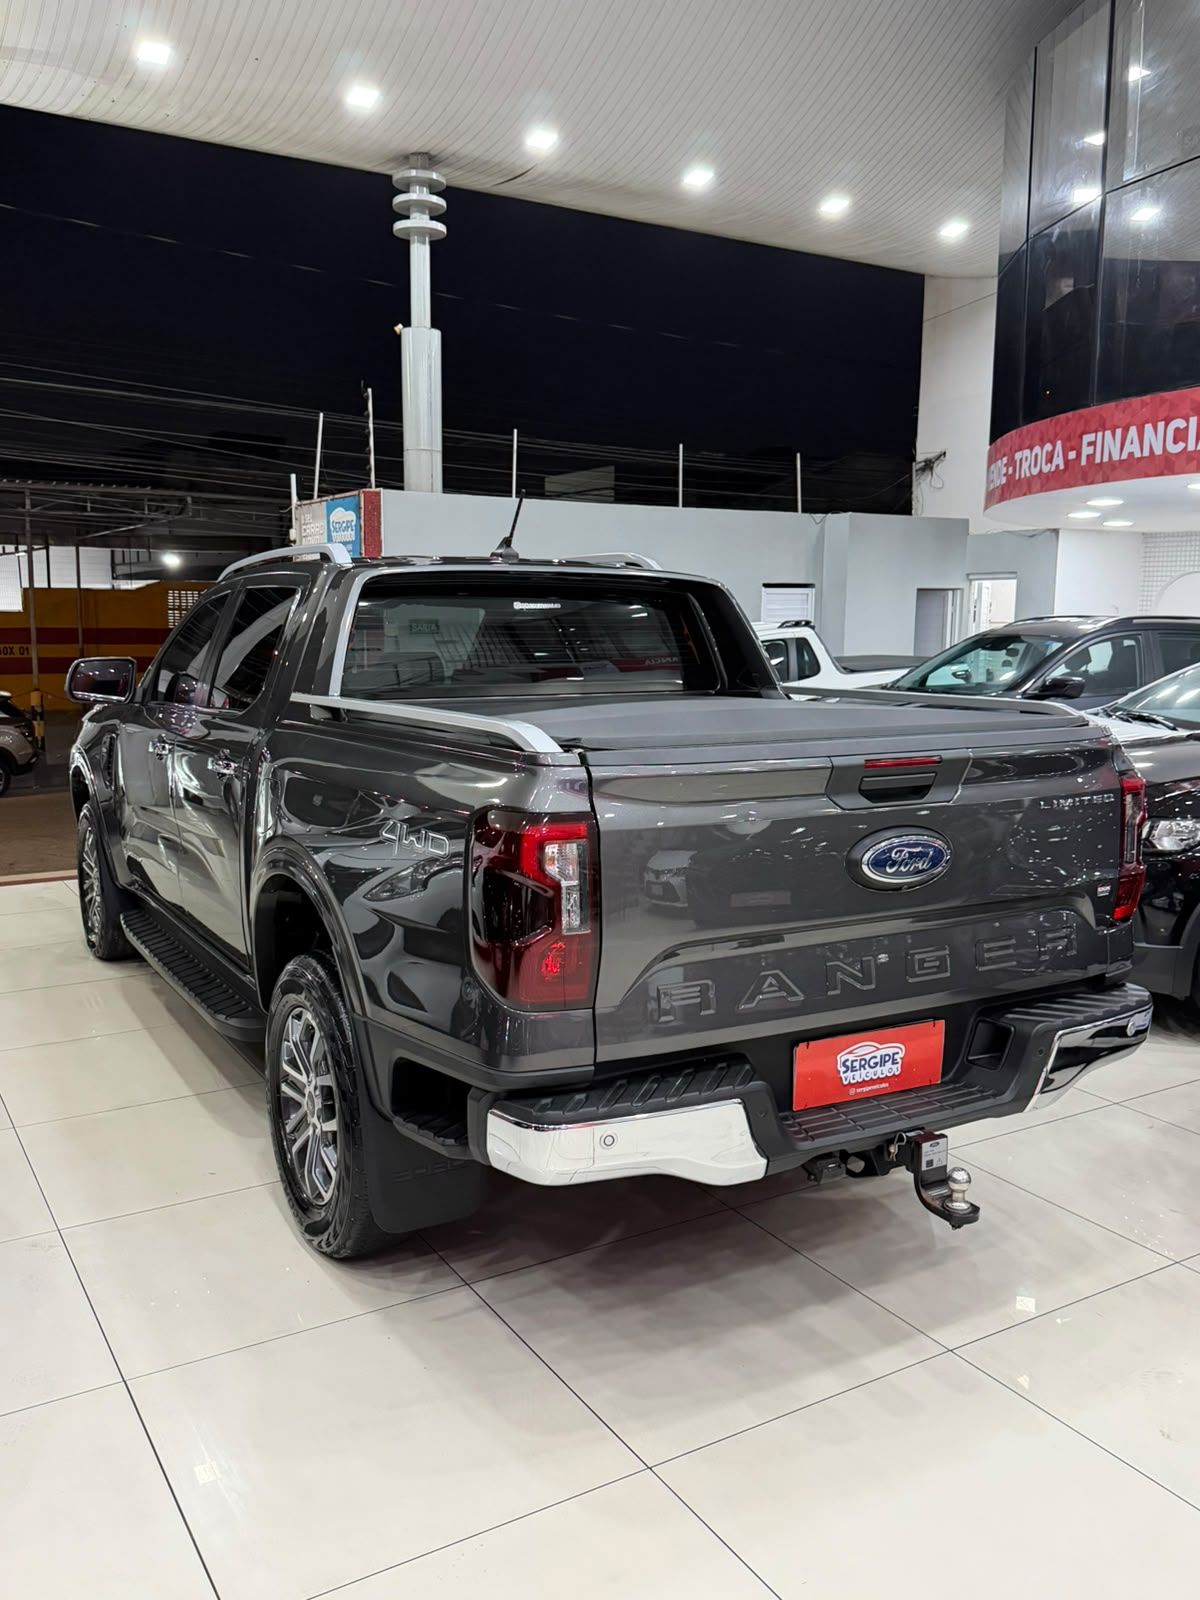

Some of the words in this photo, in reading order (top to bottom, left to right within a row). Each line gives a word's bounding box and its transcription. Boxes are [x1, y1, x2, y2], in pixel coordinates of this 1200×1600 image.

[1014, 441, 1064, 480] TROCA
[1080, 416, 1200, 466] FINANCI
[332, 519, 354, 533] SERGIPE
[0, 646, 15, 657] OX
[19, 646, 29, 657] 01
[1040, 794, 1115, 809] LIMITED
[381, 820, 450, 860] 4WD
[886, 846, 934, 873] Ford
[656, 920, 1078, 1024] RANGER
[842, 1051, 900, 1075] SERGIPE
